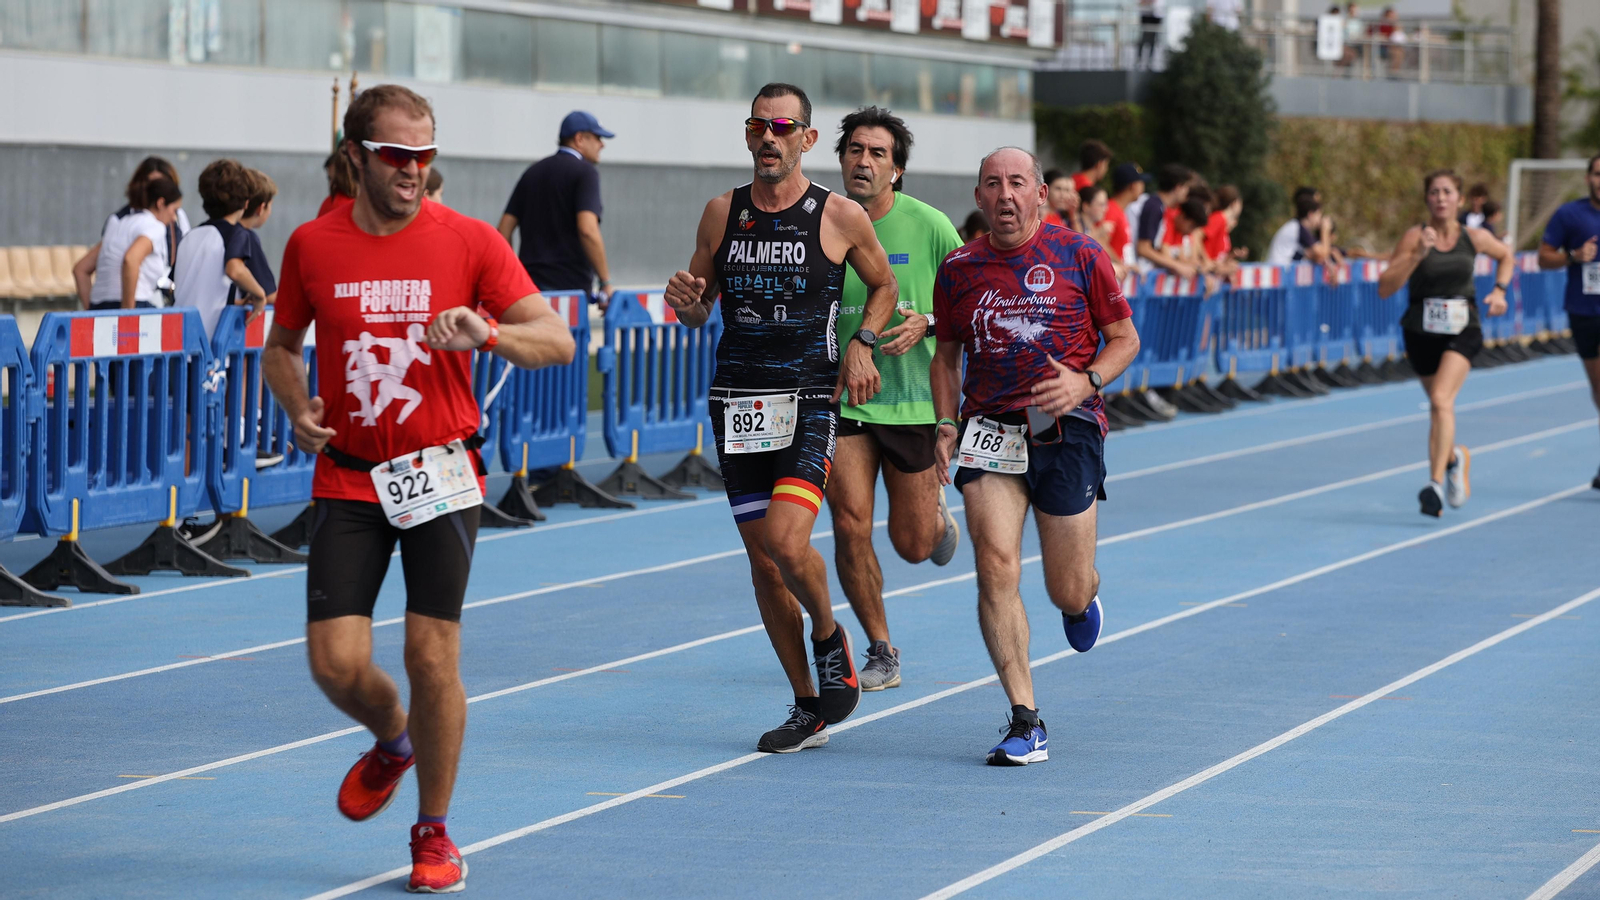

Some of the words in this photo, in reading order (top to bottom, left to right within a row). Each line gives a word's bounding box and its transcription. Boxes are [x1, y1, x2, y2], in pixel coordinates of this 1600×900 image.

[727, 240, 806, 264] PALMERO
[334, 282, 360, 298] XLII
[360, 279, 432, 296] CARRERA
[977, 289, 1000, 306] IV
[992, 295, 1018, 308] Trail
[1017, 293, 1057, 305] urbano
[360, 296, 430, 312] POPULAR
[1004, 306, 1028, 315] Ciudad
[1028, 306, 1035, 314] de
[1037, 306, 1056, 314] Arcos
[732, 411, 765, 433] 892
[972, 430, 1004, 453] 168
[387, 471, 434, 505] 922
